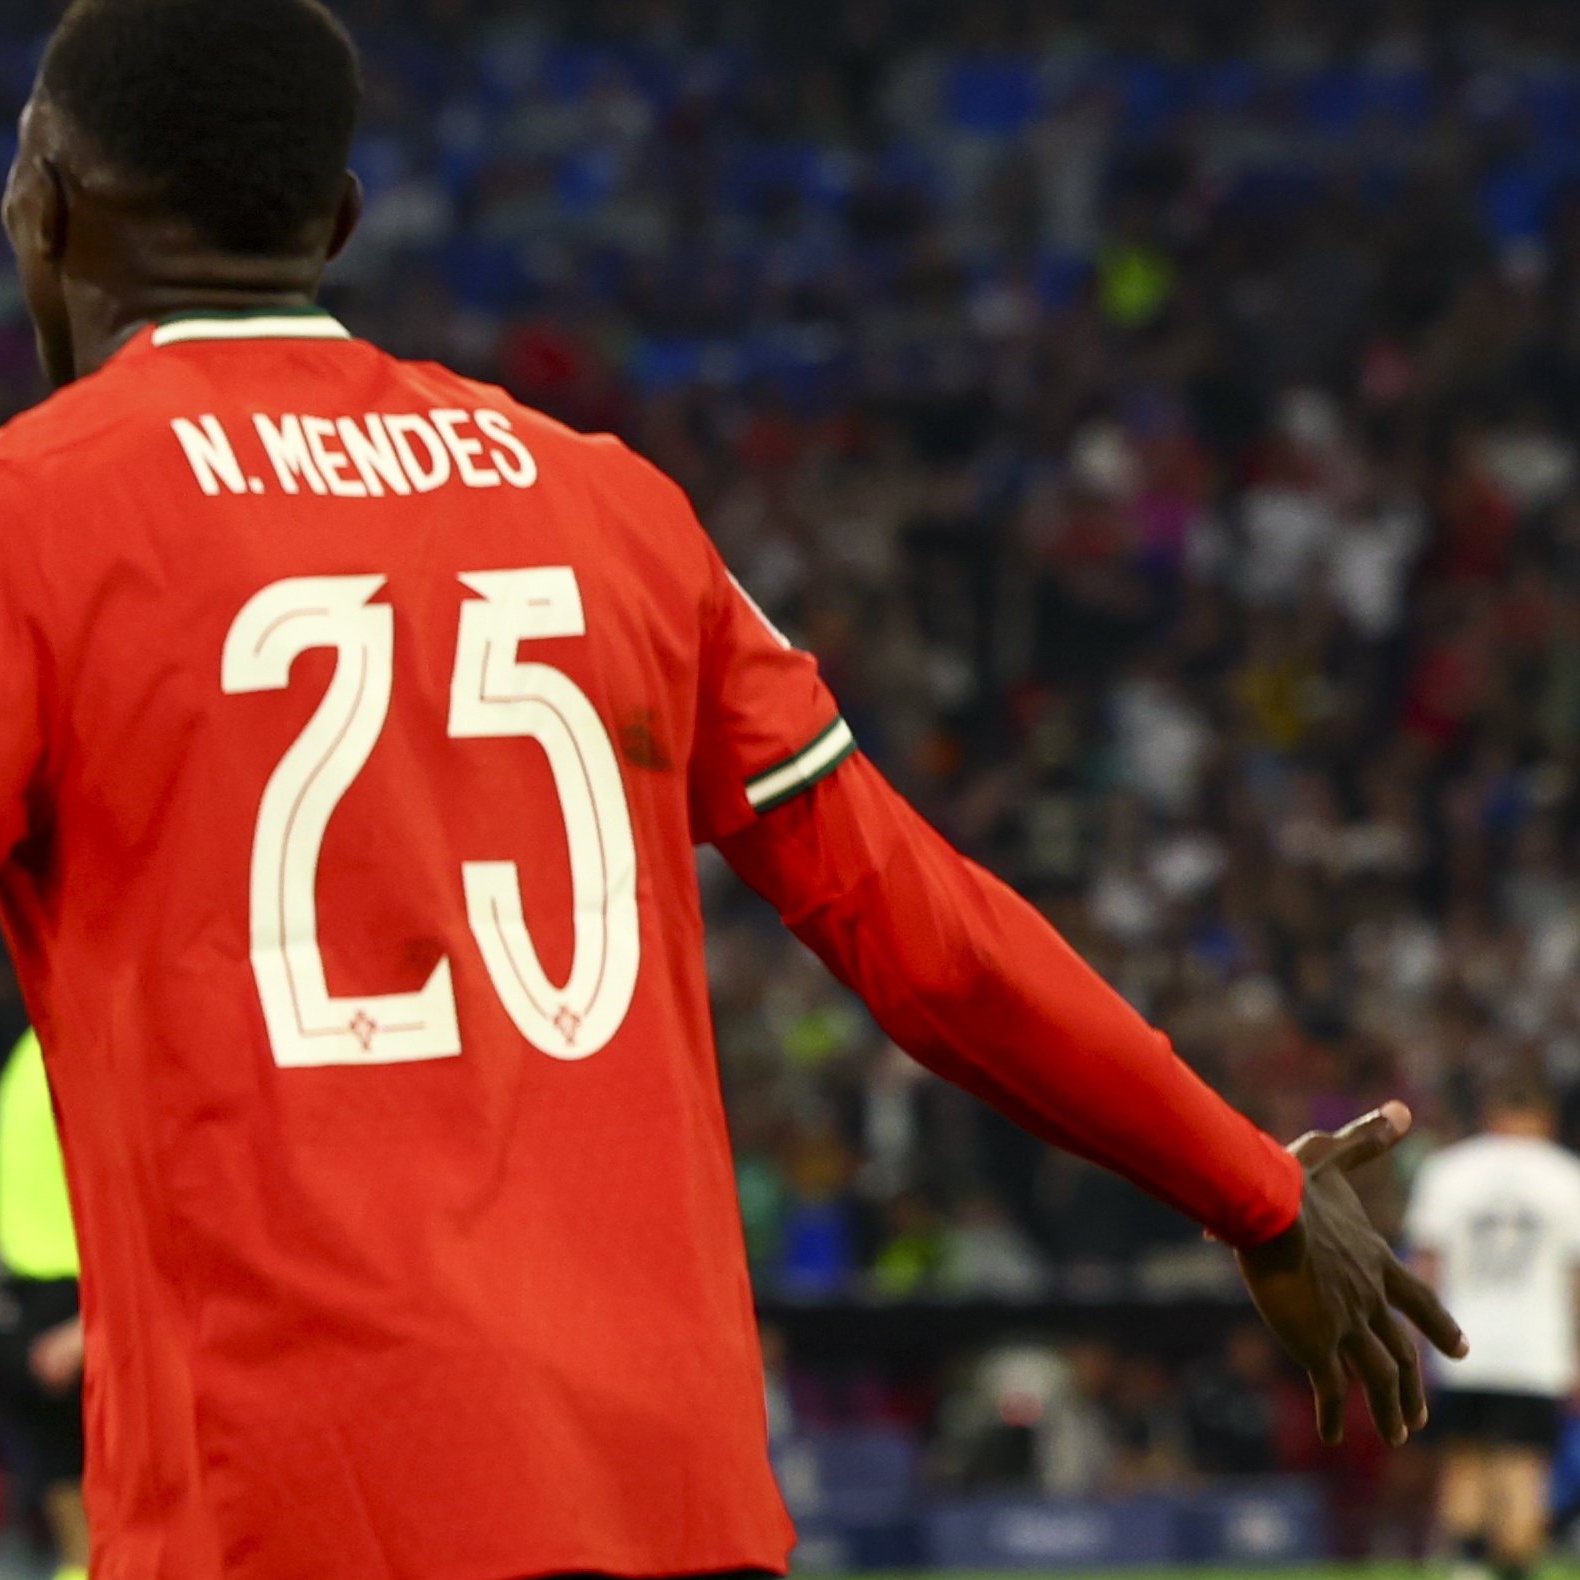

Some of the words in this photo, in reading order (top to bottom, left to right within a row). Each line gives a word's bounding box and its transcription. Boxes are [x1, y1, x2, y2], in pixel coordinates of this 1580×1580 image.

[171, 414, 263, 495] N.
[254, 409, 537, 497] MENDES
[220, 566, 640, 1068] 25
